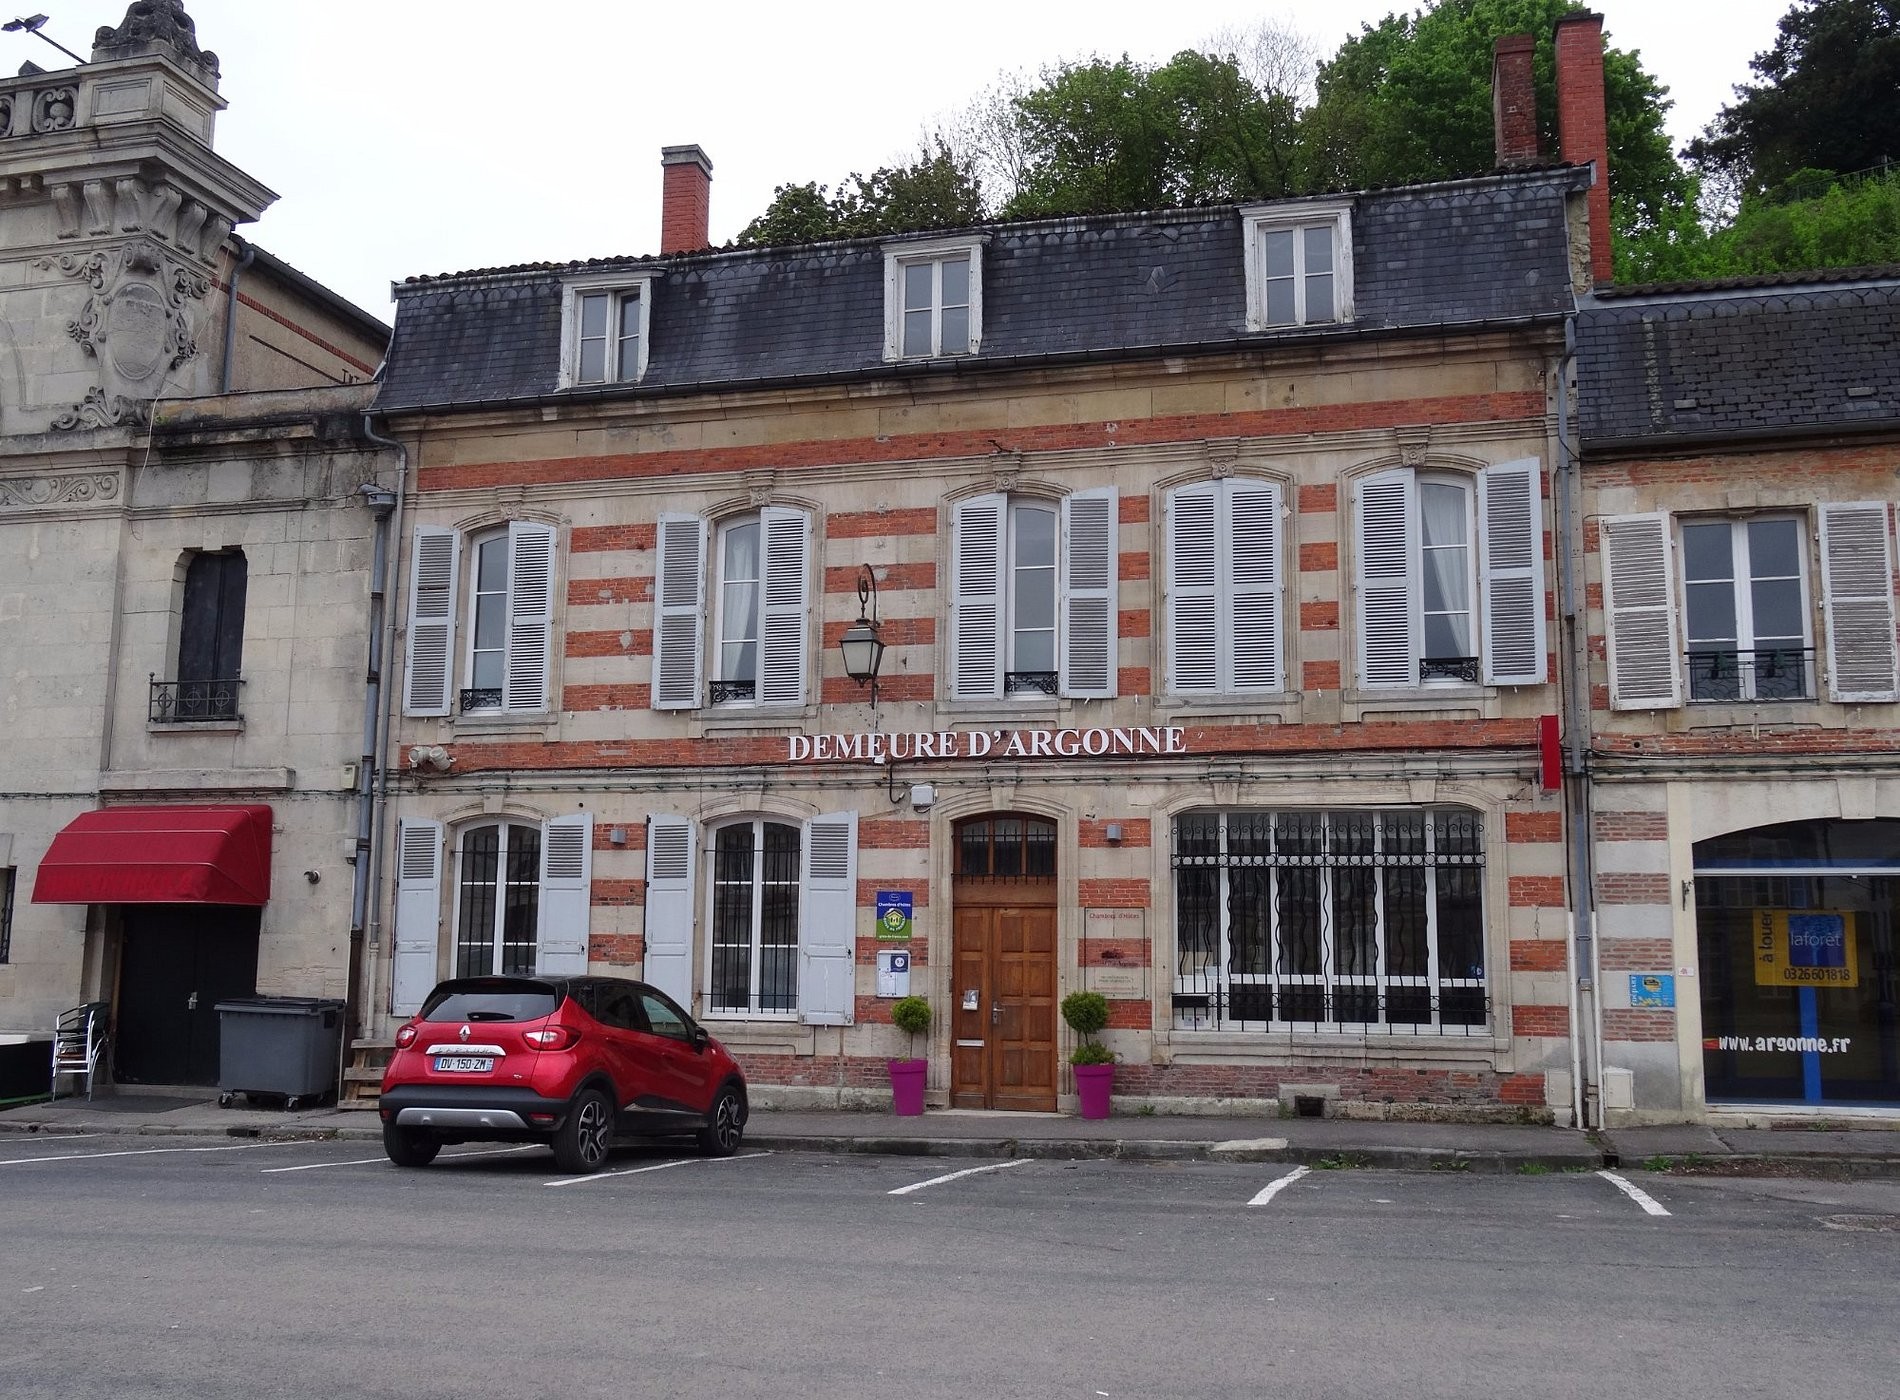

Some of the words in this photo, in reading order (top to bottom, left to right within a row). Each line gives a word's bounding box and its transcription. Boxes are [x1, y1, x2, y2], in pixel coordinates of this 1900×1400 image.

[787, 731, 960, 761] DEMEURE
[968, 726, 1187, 758] D'ARGONNE
[1758, 911, 1774, 950] louer
[1790, 931, 1841, 947] laforêt
[1718, 1036, 1851, 1053] www.argonne.fr
